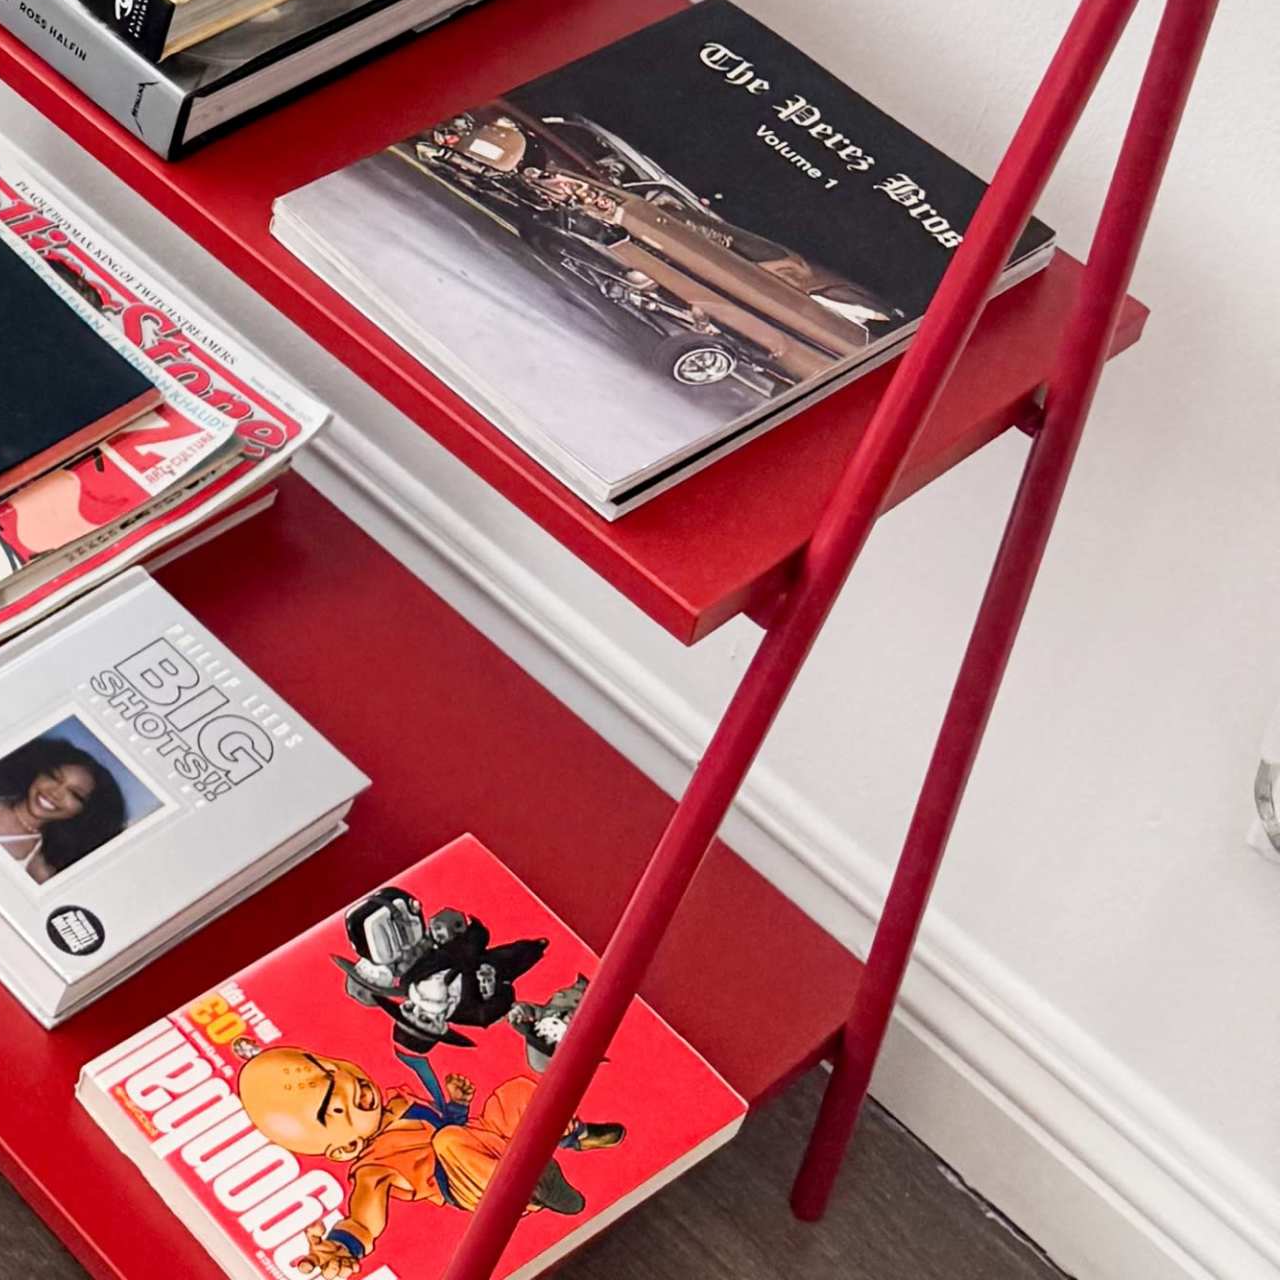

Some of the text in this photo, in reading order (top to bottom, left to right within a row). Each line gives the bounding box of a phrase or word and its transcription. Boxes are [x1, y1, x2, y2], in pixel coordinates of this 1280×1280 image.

[18, 0, 47, 31] ROSS
[49, 25, 88, 62] HALFIN
[699, 42, 964, 249] The Perez Bros
[755, 124, 840, 190] Volume 1
[93, 248, 120, 276] KING
[122, 303, 289, 461] Stone
[90, 670, 233, 802] SHOTS!!
[114, 636, 275, 786] BIG
[165, 623, 241, 688] PHILLIP
[241, 695, 304, 749] LEEDS
[191, 991, 247, 1045] 03
